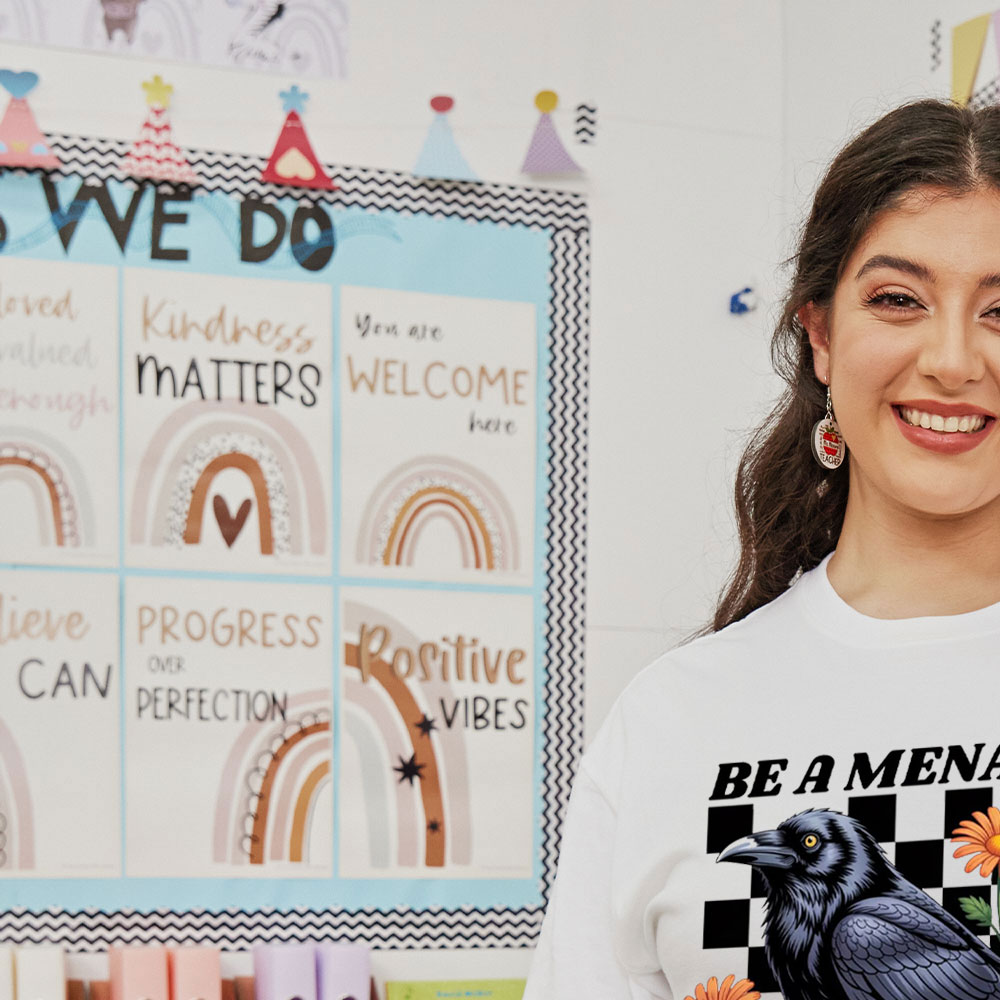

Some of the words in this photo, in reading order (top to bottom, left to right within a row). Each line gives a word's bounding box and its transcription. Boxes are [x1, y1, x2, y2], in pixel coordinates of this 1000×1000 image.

[40, 176, 192, 260] WE
[240, 199, 335, 272] DO
[141, 296, 317, 353] Kindness
[355, 311, 399, 342] You
[408, 321, 444, 343] are
[347, 355, 529, 406] WELCOME
[469, 411, 517, 436] here
[138, 605, 323, 648] PROGRESS
[149, 655, 186, 674] OVER
[357, 623, 527, 686] Positive
[19, 658, 112, 700] CAN
[137, 687, 288, 722] PERFECTION
[438, 696, 528, 731] VIBES
[708, 758, 788, 801] BE
[793, 754, 836, 795] A
